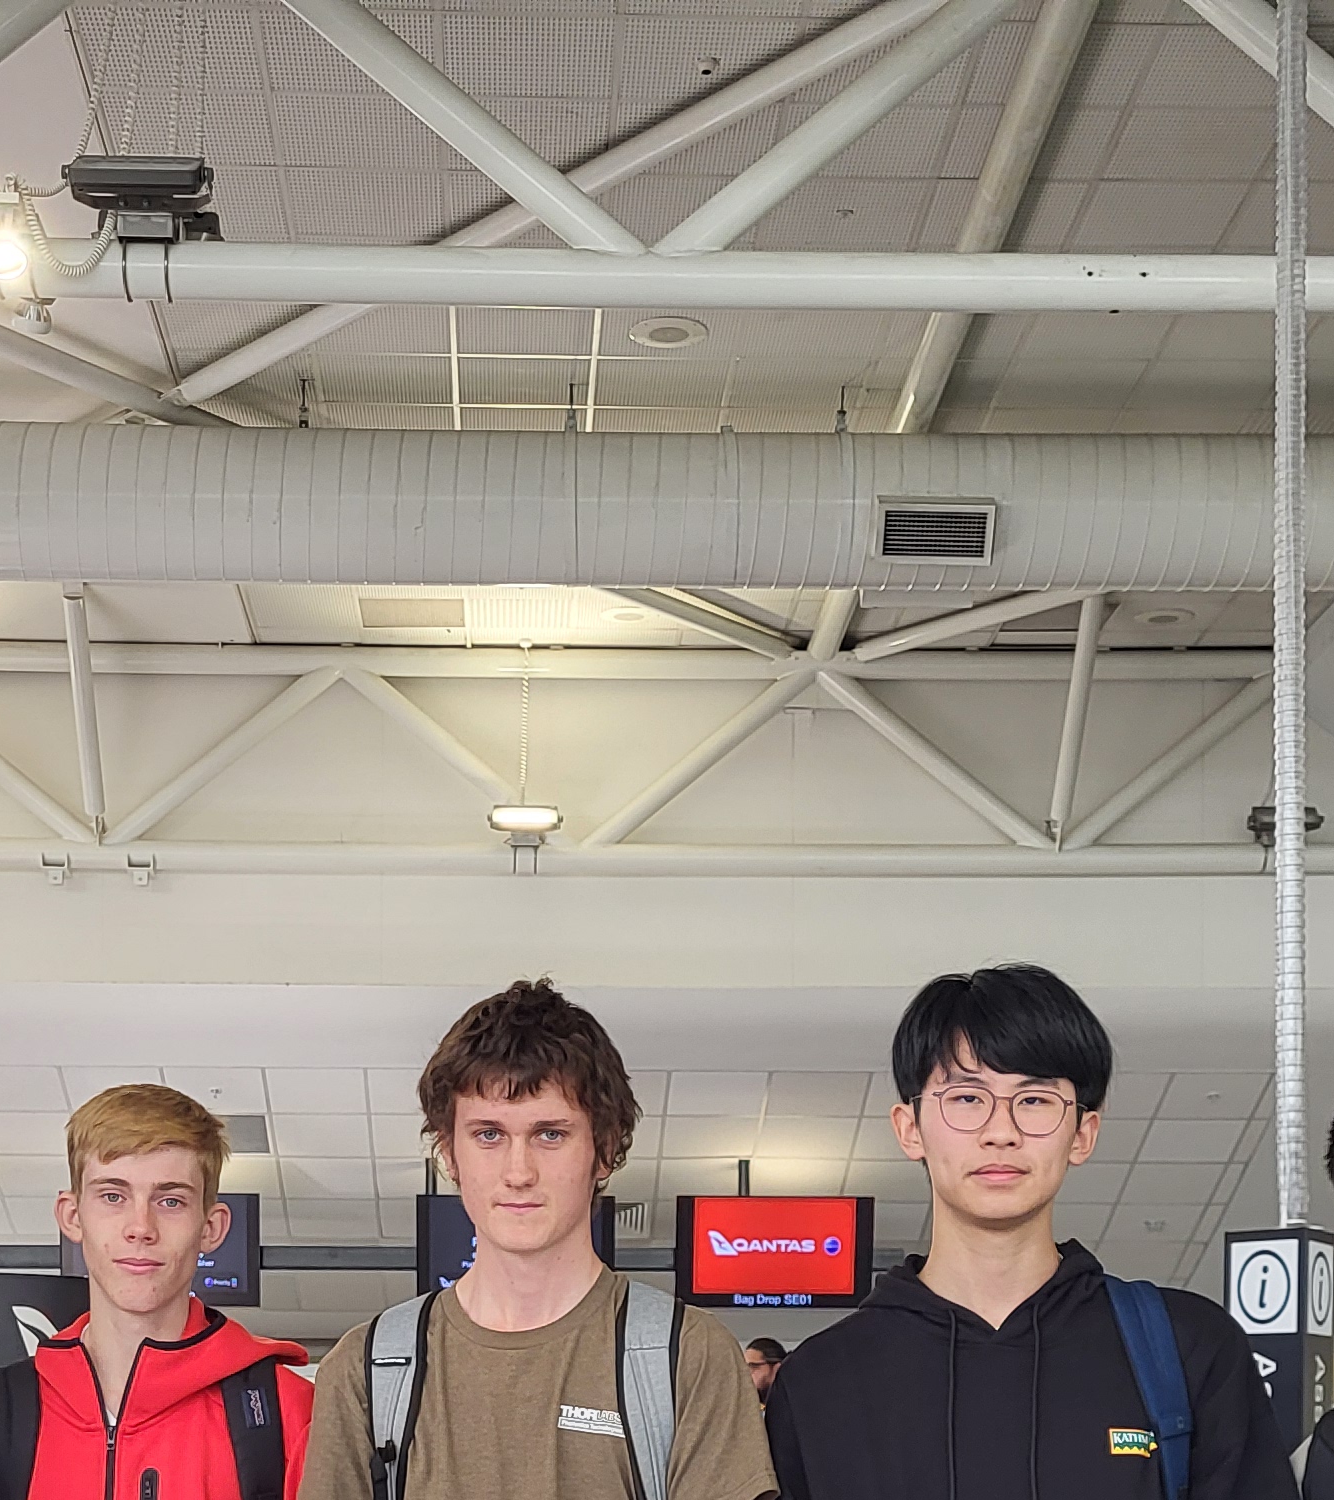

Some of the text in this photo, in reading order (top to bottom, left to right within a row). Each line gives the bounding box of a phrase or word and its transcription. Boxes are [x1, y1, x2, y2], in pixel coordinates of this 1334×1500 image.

[732, 1238, 816, 1253] QANTAS
[733, 1293, 813, 1306] Bag Drop SE01
